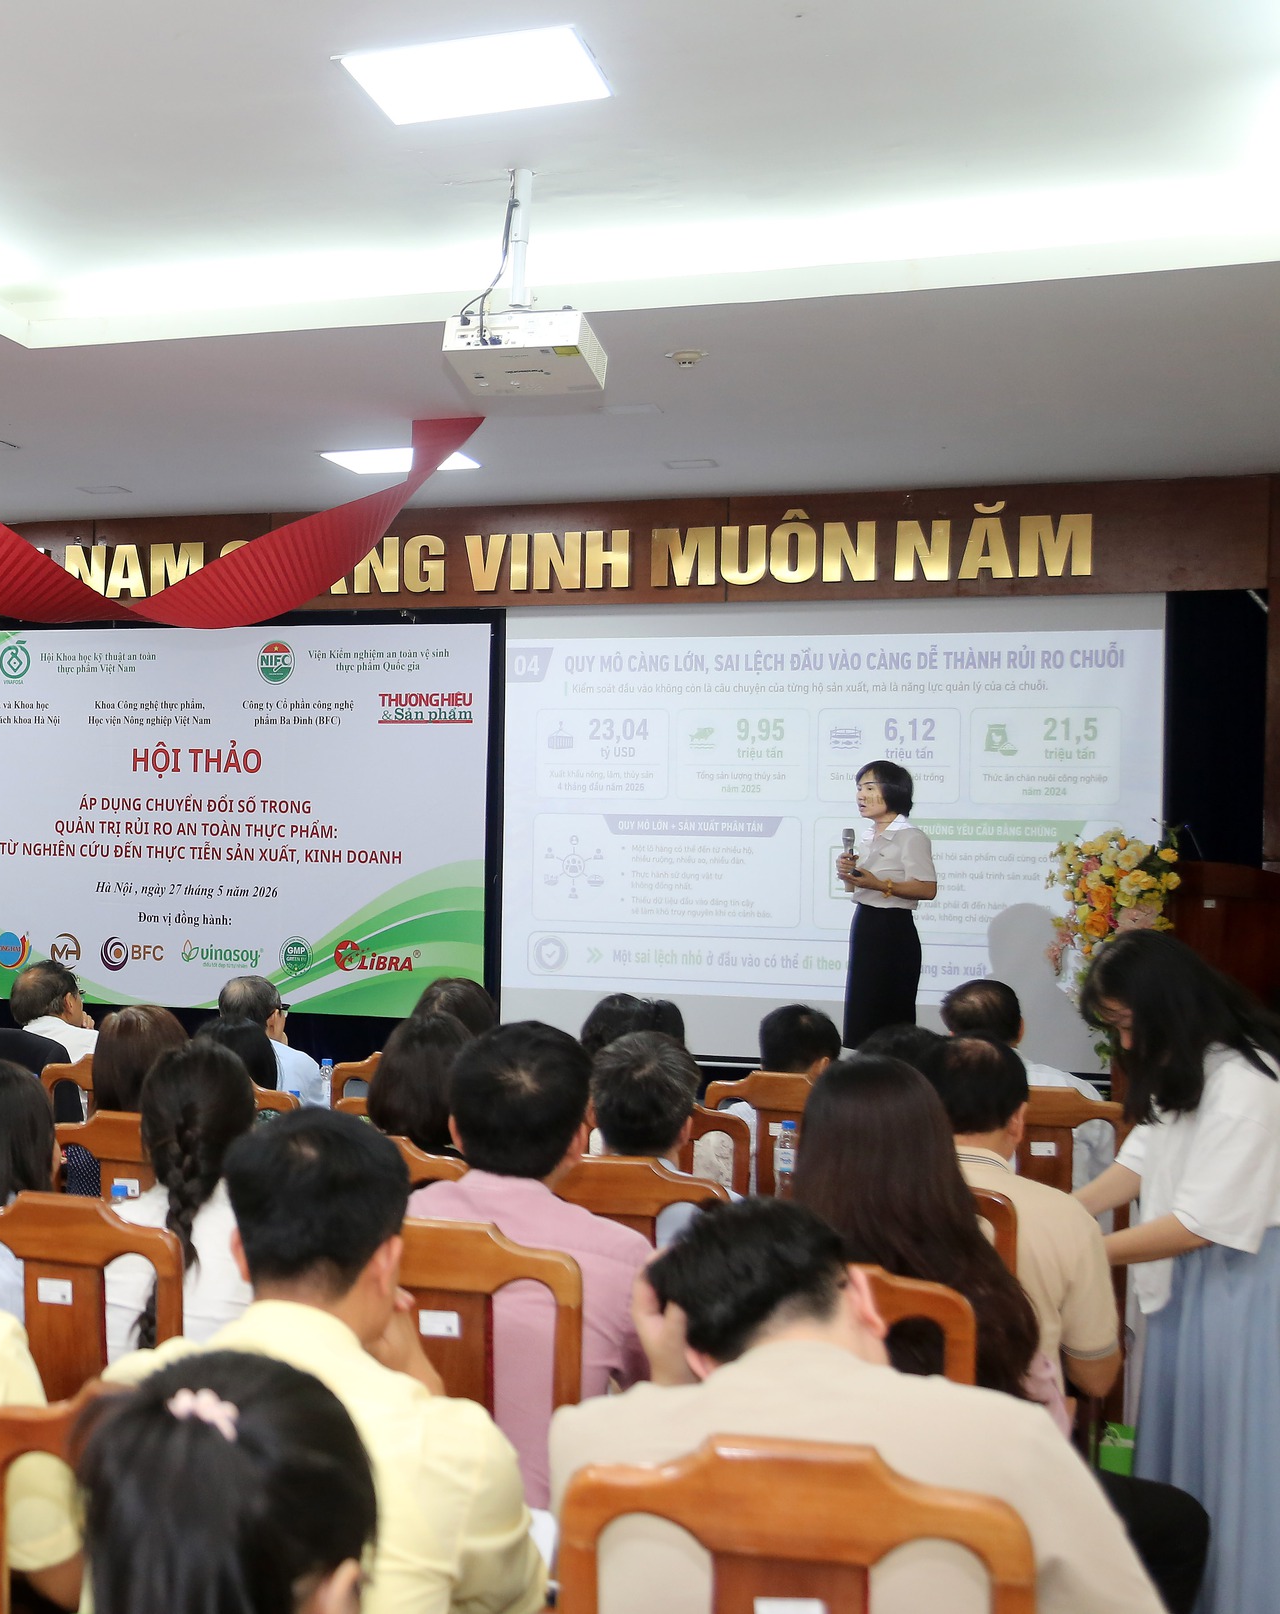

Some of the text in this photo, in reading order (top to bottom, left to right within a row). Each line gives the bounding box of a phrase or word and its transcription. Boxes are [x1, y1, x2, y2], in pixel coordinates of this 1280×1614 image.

[65, 543, 206, 598] NAM
[465, 529, 629, 592] VINH
[651, 509, 877, 587] MUÔN
[894, 502, 1093, 582] NĂM
[40, 652, 53, 663] Hội
[56, 652, 76, 661] Khoa
[78, 652, 91, 664] học
[93, 652, 103, 664] kỹ
[105, 651, 125, 664] thuật
[139, 651, 156, 660] toàn
[308, 649, 326, 661] Viện
[329, 648, 351, 659] Kiểm
[353, 649, 384, 661] nghiệm
[399, 649, 417, 658] toàn
[420, 648, 429, 660] vệ
[432, 648, 449, 657] sinh
[565, 641, 1125, 675] QUY MÔ CÀNG LỚN, SAI LỆCH ĐẦU VÀO CÀNG DỄ THÀNH RỦI RO CHUỖI
[57, 662, 135, 674] thực phẩm Việt Nam
[336, 661, 420, 673] thực phẩm Quốc gia
[514, 655, 540, 675] 04
[3, 700, 11, 709] và
[14, 700, 34, 709] Khoa
[36, 700, 49, 711] học
[94, 699, 205, 711] Khoa Công nghệ thực phẩm,
[242, 699, 354, 711] Công ty Cổ phần công nghệ
[13, 715, 31, 724] khoa
[34, 715, 45, 724] Hà
[47, 715, 60, 726] Nội
[88, 715, 211, 726] Học viện Nông nghiệp Việt Nam
[254, 714, 341, 727] phẩm Ba Đình (BFC)
[381, 708, 473, 723] & Sản phẩm
[588, 718, 650, 743] 23,04
[735, 718, 787, 744] 9,95
[883, 717, 938, 744] 6,12
[1042, 716, 1100, 744] 21,5
[132, 740, 262, 778] HỘI THẢO
[79, 793, 311, 814] ÁP DỤNG CHUYỂN ĐỔI SỐ TRONG
[54, 817, 337, 840] QUẢN TRỊ RỦI RO AN TOÀN THỰC PHẨM:
[0, 838, 401, 864] TỪ NGHIÊN CỨU ĐẾN THỰC TIỄN SẢN XUẤT, KINH DOANH
[95, 881, 278, 899] Hà Nội ngày 27 tháng 5 năm 2026
[138, 911, 231, 927] Đơn vị đồng hành:
[131, 945, 164, 961] BFC
[287, 947, 306, 955] GMP
